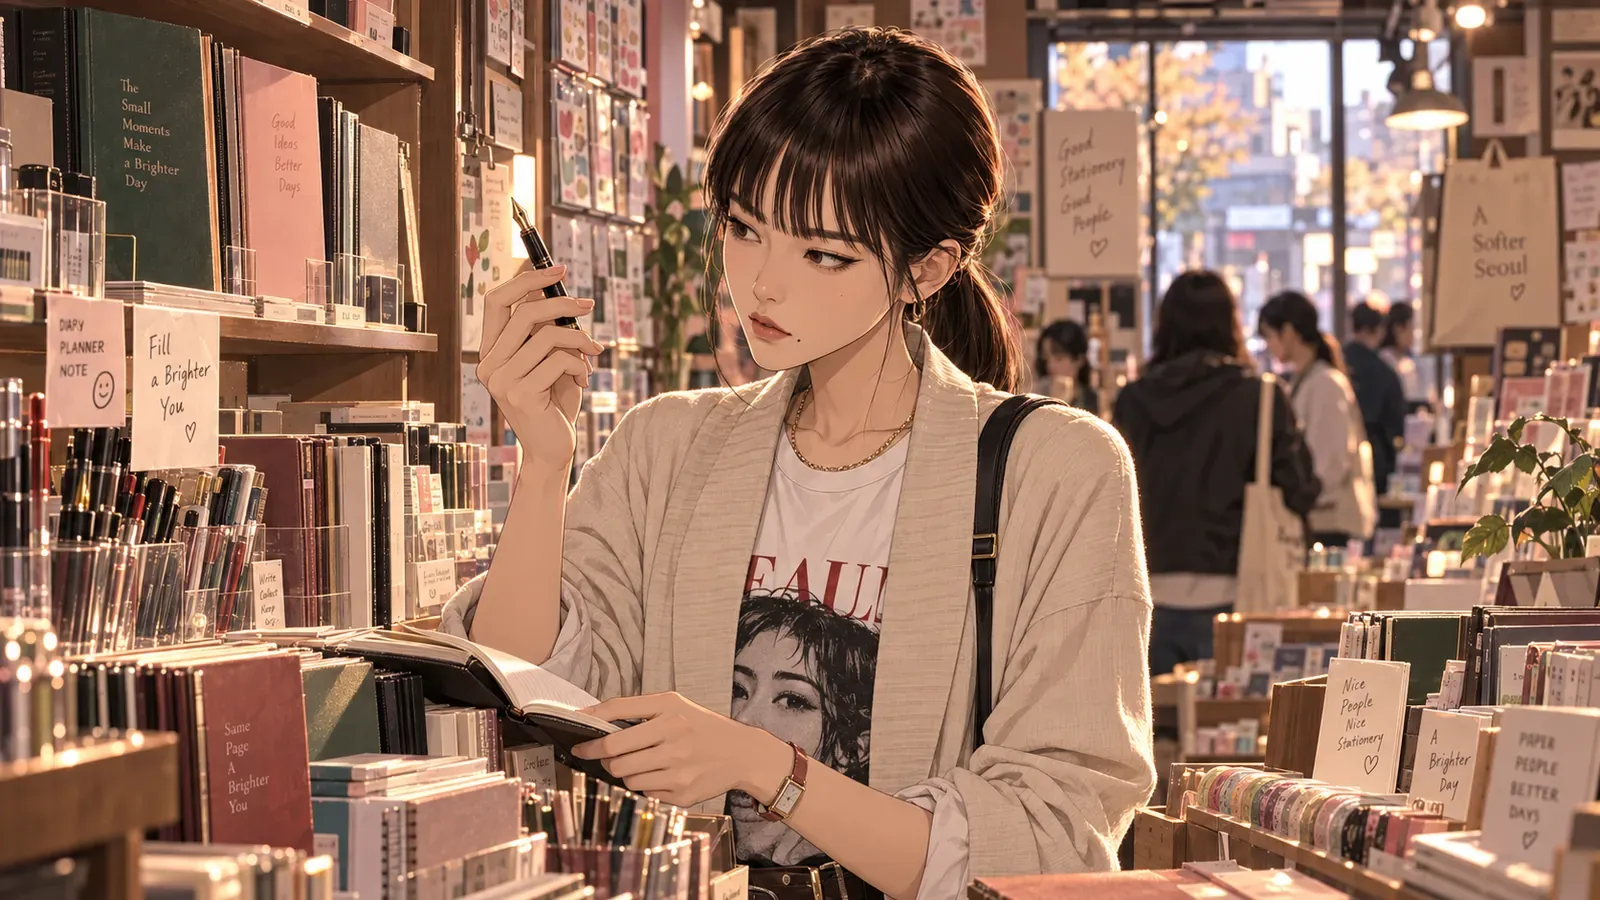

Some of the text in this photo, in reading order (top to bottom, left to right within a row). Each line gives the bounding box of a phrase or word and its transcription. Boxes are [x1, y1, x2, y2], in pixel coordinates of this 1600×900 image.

[120, 78, 139, 94] The
[121, 99, 151, 116] Small
[122, 118, 171, 137] Moments
[271, 113, 296, 130] Good
[123, 136, 152, 153] Make
[274, 135, 299, 151] Ideas
[1059, 126, 1093, 162] Good
[124, 157, 180, 177] a Brighter
[275, 156, 303, 173] Better
[1060, 156, 1126, 188] Stationery
[125, 174, 148, 192] Day
[279, 177, 301, 198] Days
[1061, 187, 1092, 215] Good
[1073, 204, 1113, 235] People
[1473, 206, 1488, 226] A
[1473, 231, 1527, 254] Softer
[1474, 255, 1528, 279] Seoul
[59, 318, 84, 332] DIARY
[60, 340, 105, 354] PLANNER
[149, 333, 171, 360] Fill
[59, 363, 88, 378] NOTE
[151, 358, 211, 391] a Brighter
[160, 395, 185, 421] You
[259, 574, 277, 586] Write
[1342, 678, 1366, 694] Nice
[1340, 693, 1373, 716] People
[224, 721, 251, 737] Same
[1346, 717, 1366, 731] Nice
[1337, 732, 1384, 752] Stationery
[1430, 729, 1438, 745] A
[1519, 732, 1556, 750] PAPER
[225, 740, 249, 757] Page
[228, 762, 236, 775] A
[1429, 752, 1471, 774] Brighter
[1515, 756, 1558, 776] PEOPLE
[228, 774, 269, 796] Brighter
[1439, 777, 1459, 800] Day
[1511, 782, 1559, 802] BETTER
[229, 800, 248, 815] You
[1509, 805, 1541, 825] DAYS
